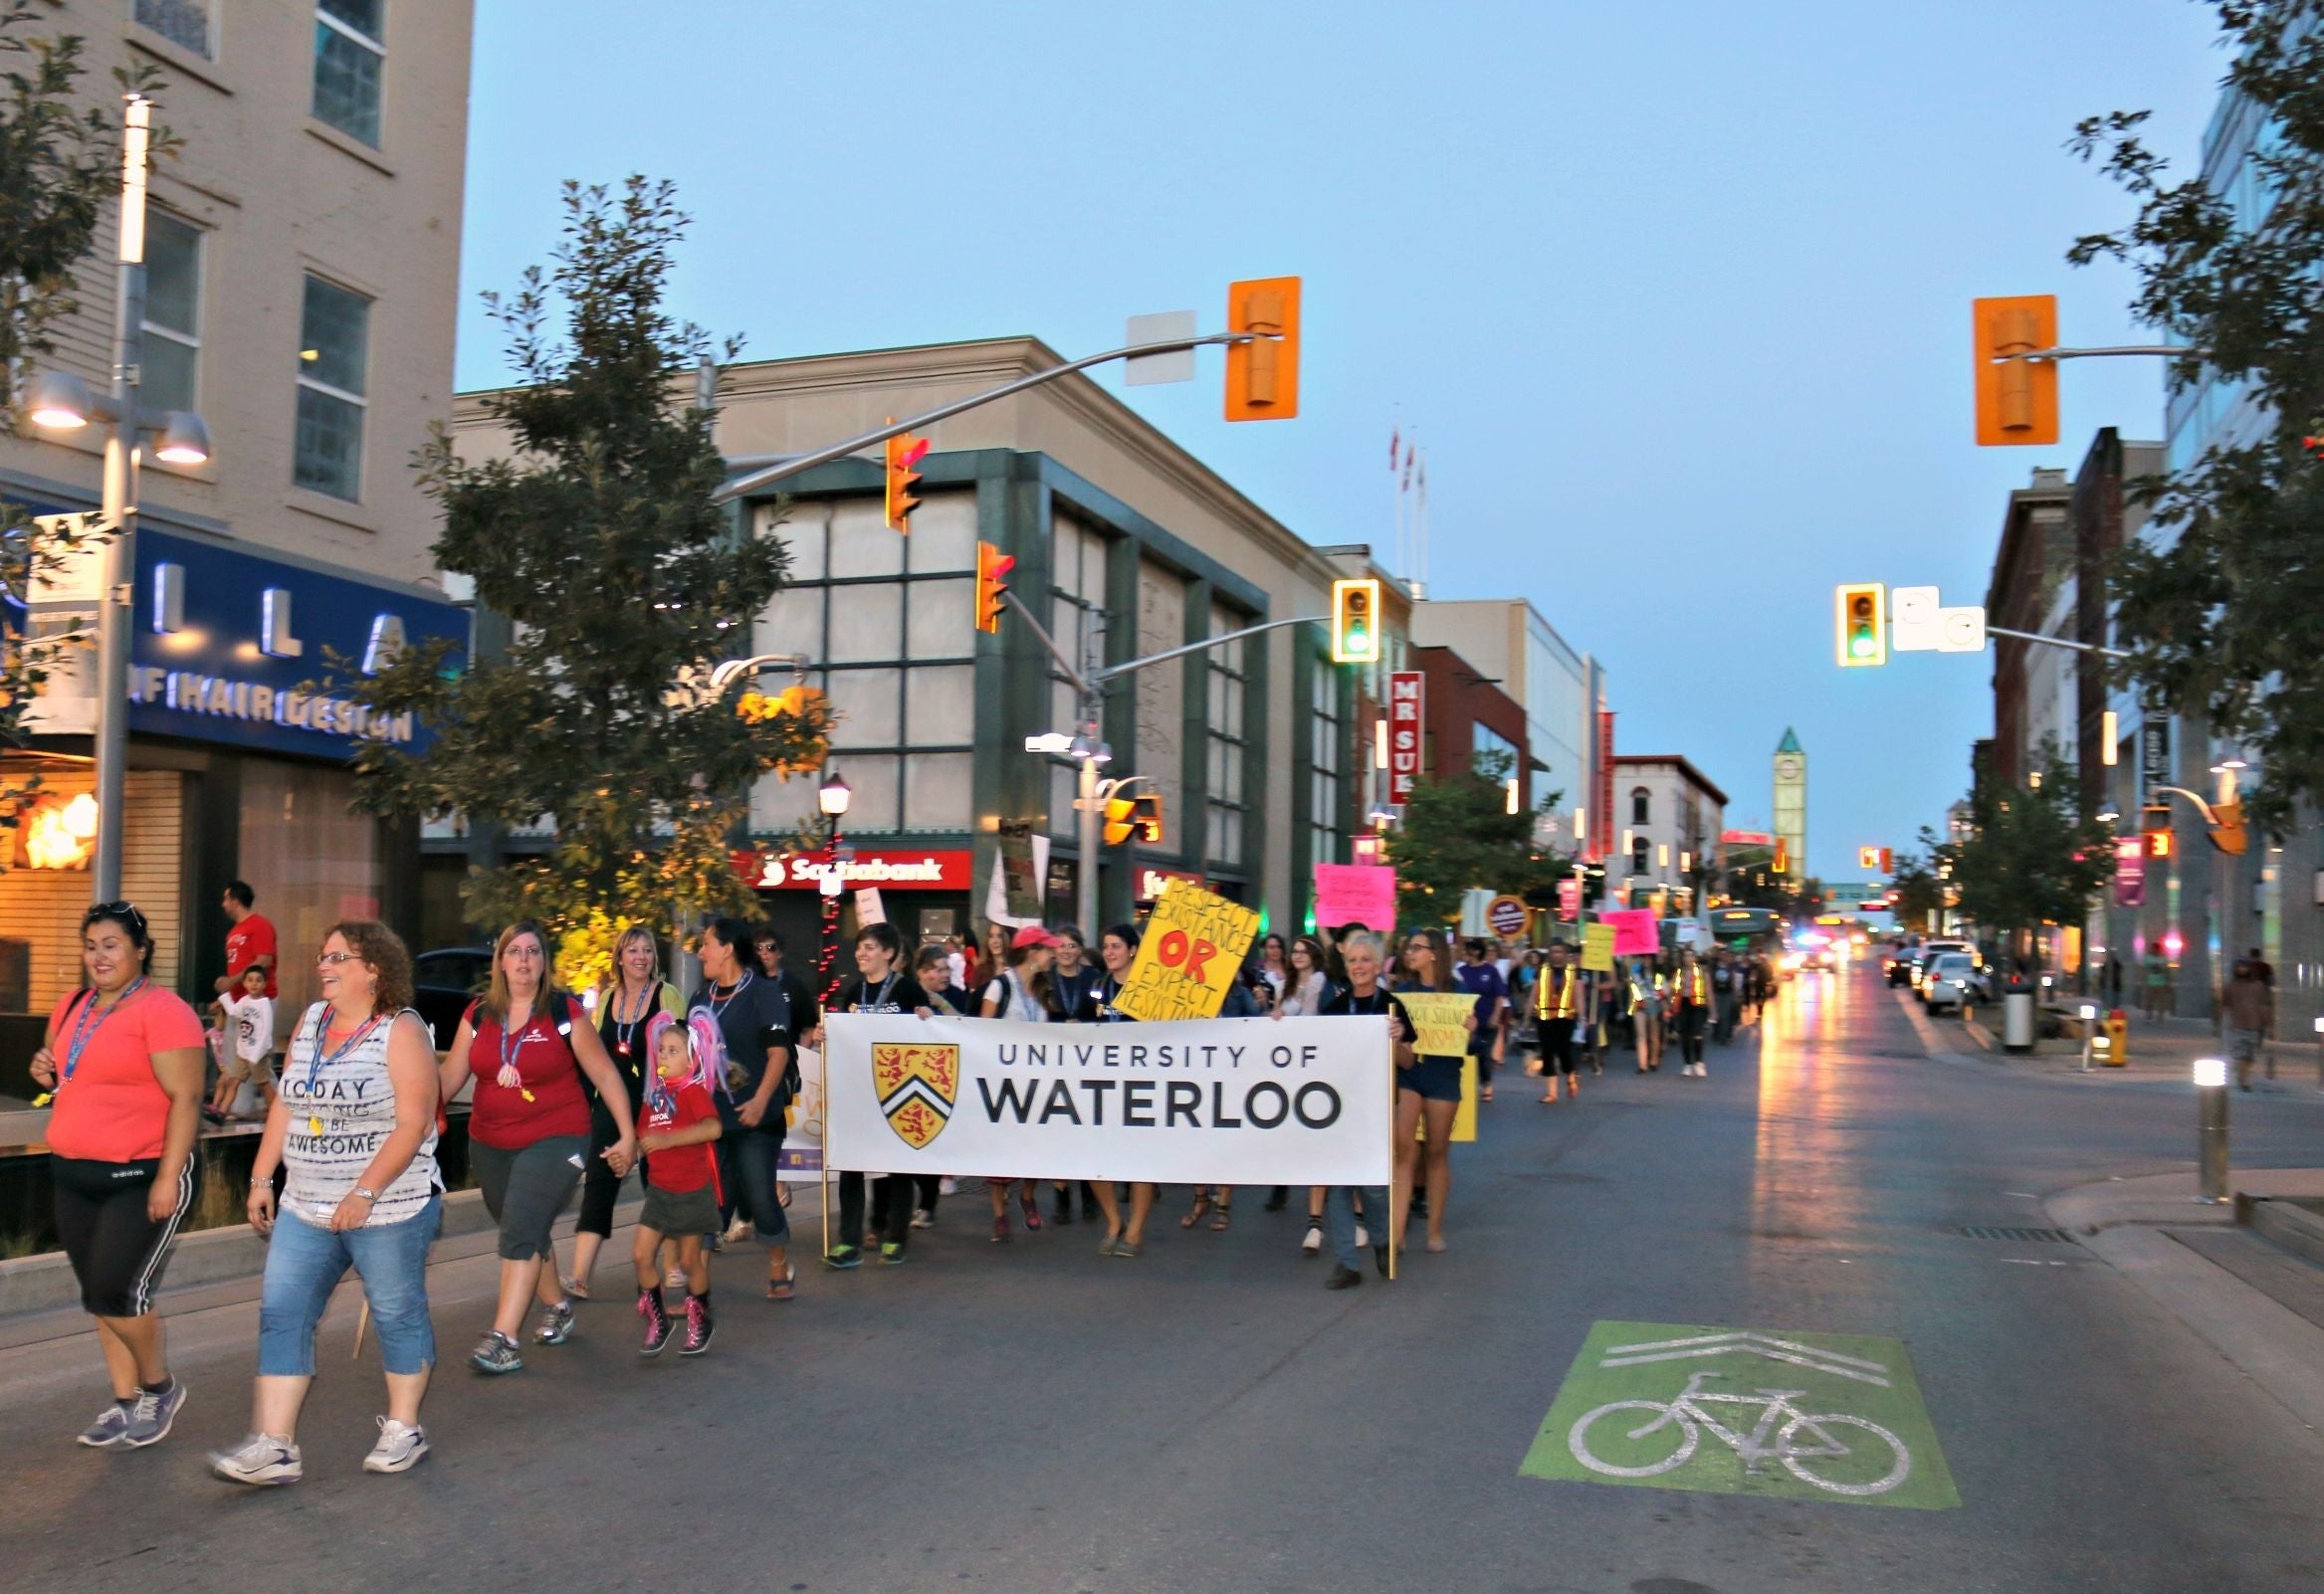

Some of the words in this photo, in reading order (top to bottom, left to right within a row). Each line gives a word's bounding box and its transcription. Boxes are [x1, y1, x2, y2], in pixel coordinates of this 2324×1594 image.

[167, 671, 275, 722] HAIR
[275, 691, 413, 742] DESIGN
[1393, 681, 1418, 720] MR
[1170, 879, 1258, 932] RESPECT
[1158, 929, 1216, 985] OR
[1141, 962, 1217, 1009] EXPECT
[998, 1044, 1246, 1069] UNIVERSITY
[1271, 1045, 1318, 1069] OF
[284, 1079, 368, 1099] TODAY
[976, 1078, 1342, 1129] WATERLOO
[288, 1136, 375, 1155] AWESOME
[330, 1118, 350, 1131] BE
